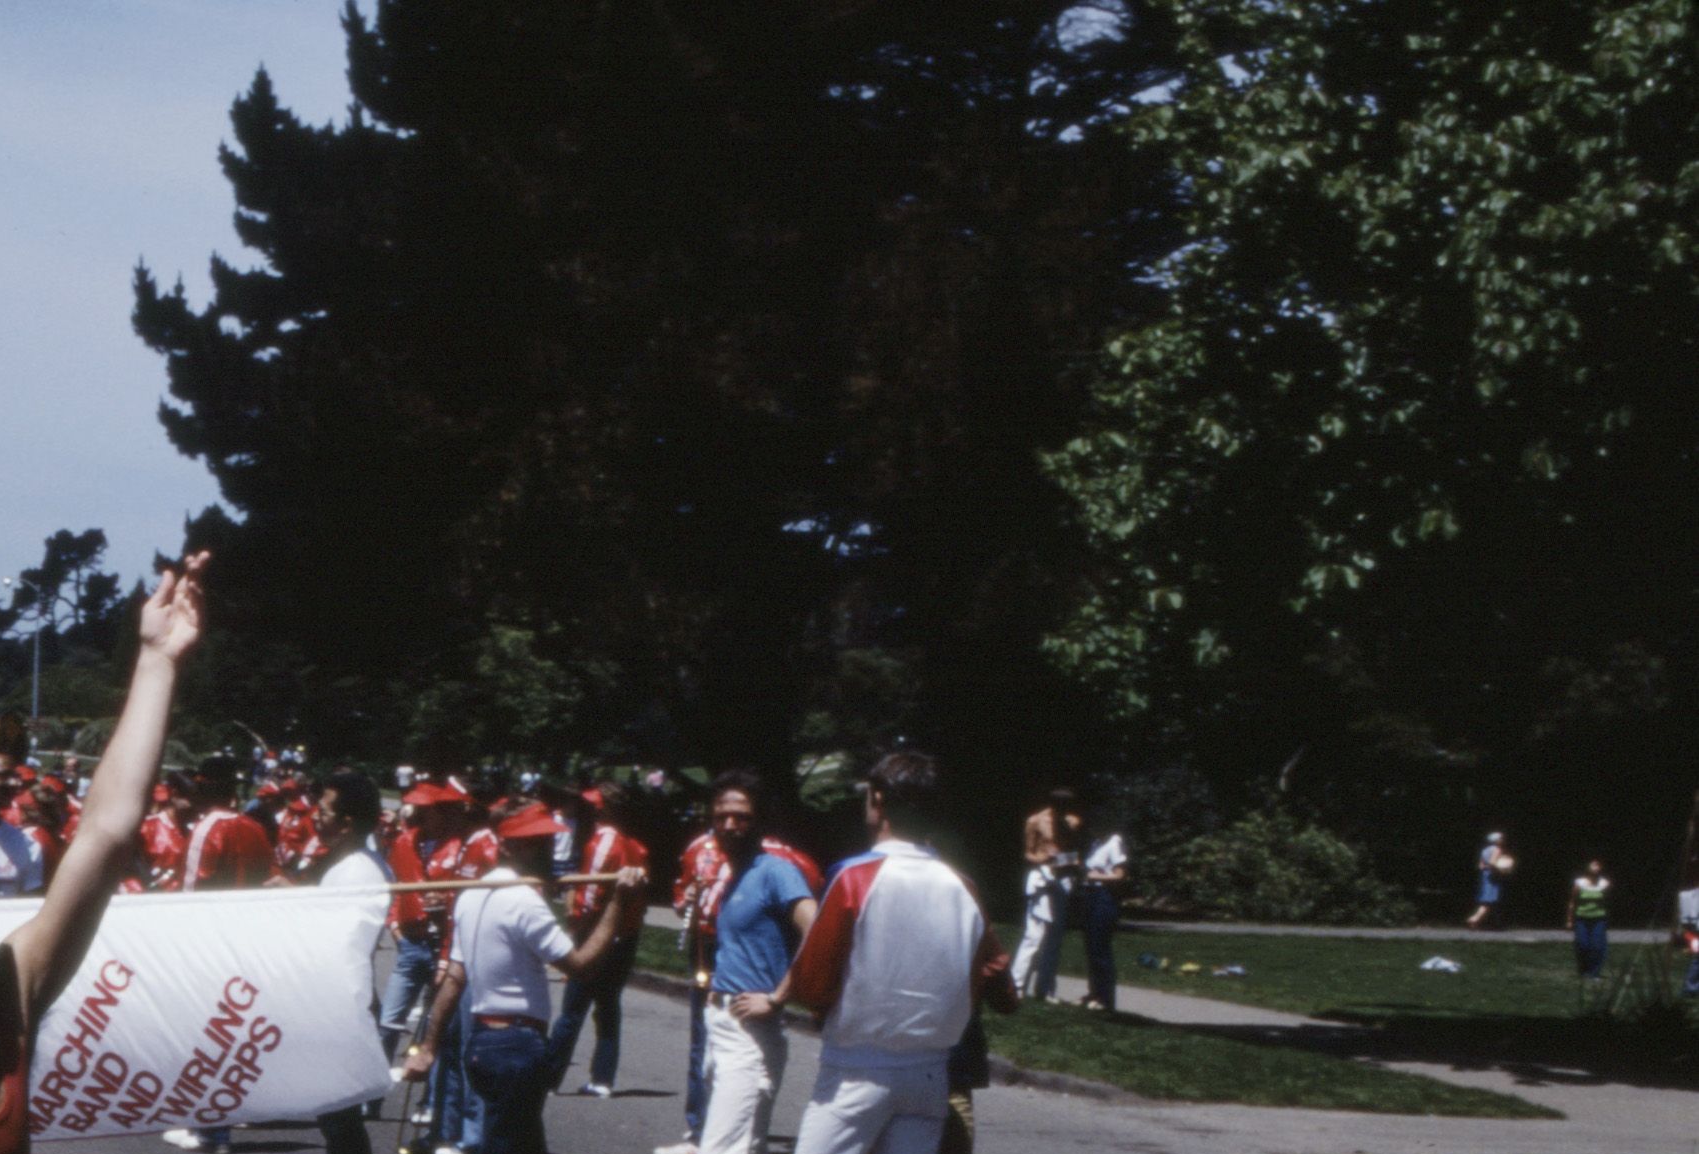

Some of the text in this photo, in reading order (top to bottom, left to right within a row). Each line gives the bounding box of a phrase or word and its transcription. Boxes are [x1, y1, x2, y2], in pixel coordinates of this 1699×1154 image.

[60, 1051, 129, 1133] BAND
[146, 976, 260, 1126] TWIRLING
[194, 1015, 283, 1125] CORPS
[107, 1070, 164, 1129] AND
